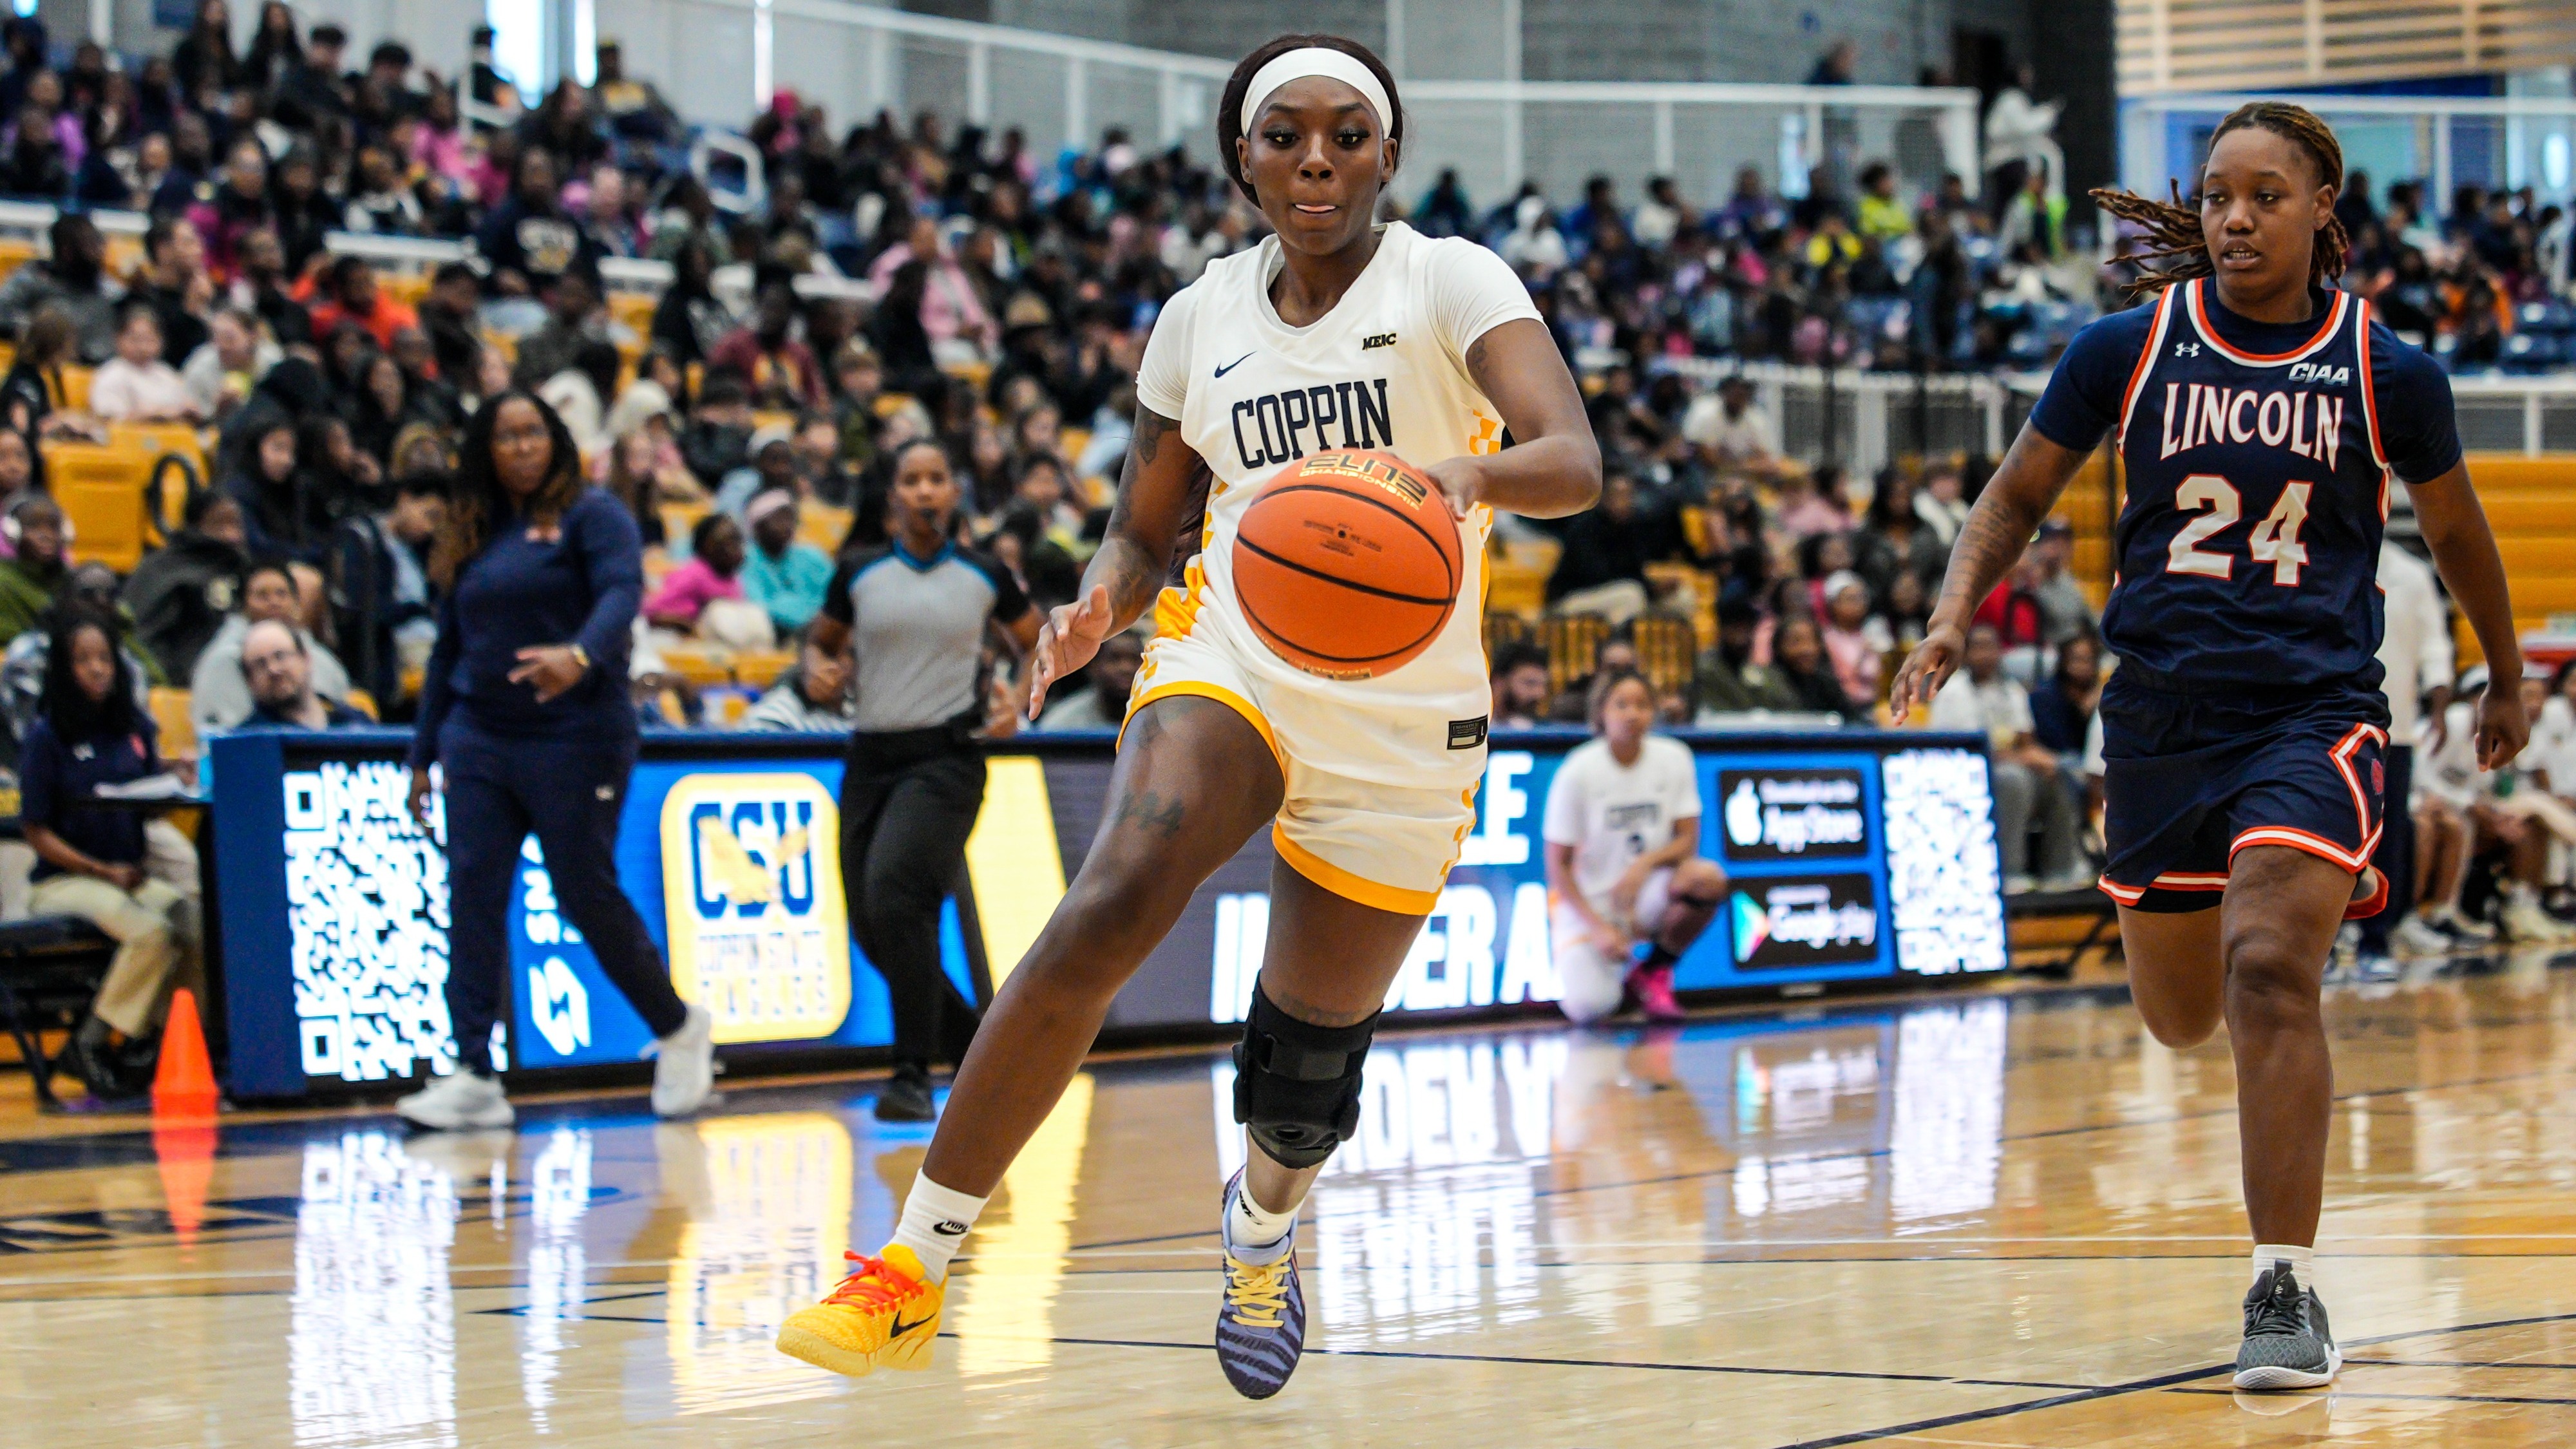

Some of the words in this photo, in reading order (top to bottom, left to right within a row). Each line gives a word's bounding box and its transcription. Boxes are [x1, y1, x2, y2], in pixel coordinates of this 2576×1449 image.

[2288, 362, 2349, 387] CIAA
[1232, 378, 1393, 469] COPPIN
[2160, 382, 2343, 473] LINCOLN
[1298, 467, 1420, 511] CHAMPIONSHIP
[1302, 453, 1428, 506] ELITE
[2165, 473, 2314, 587] 24
[689, 800, 813, 920] CSU
